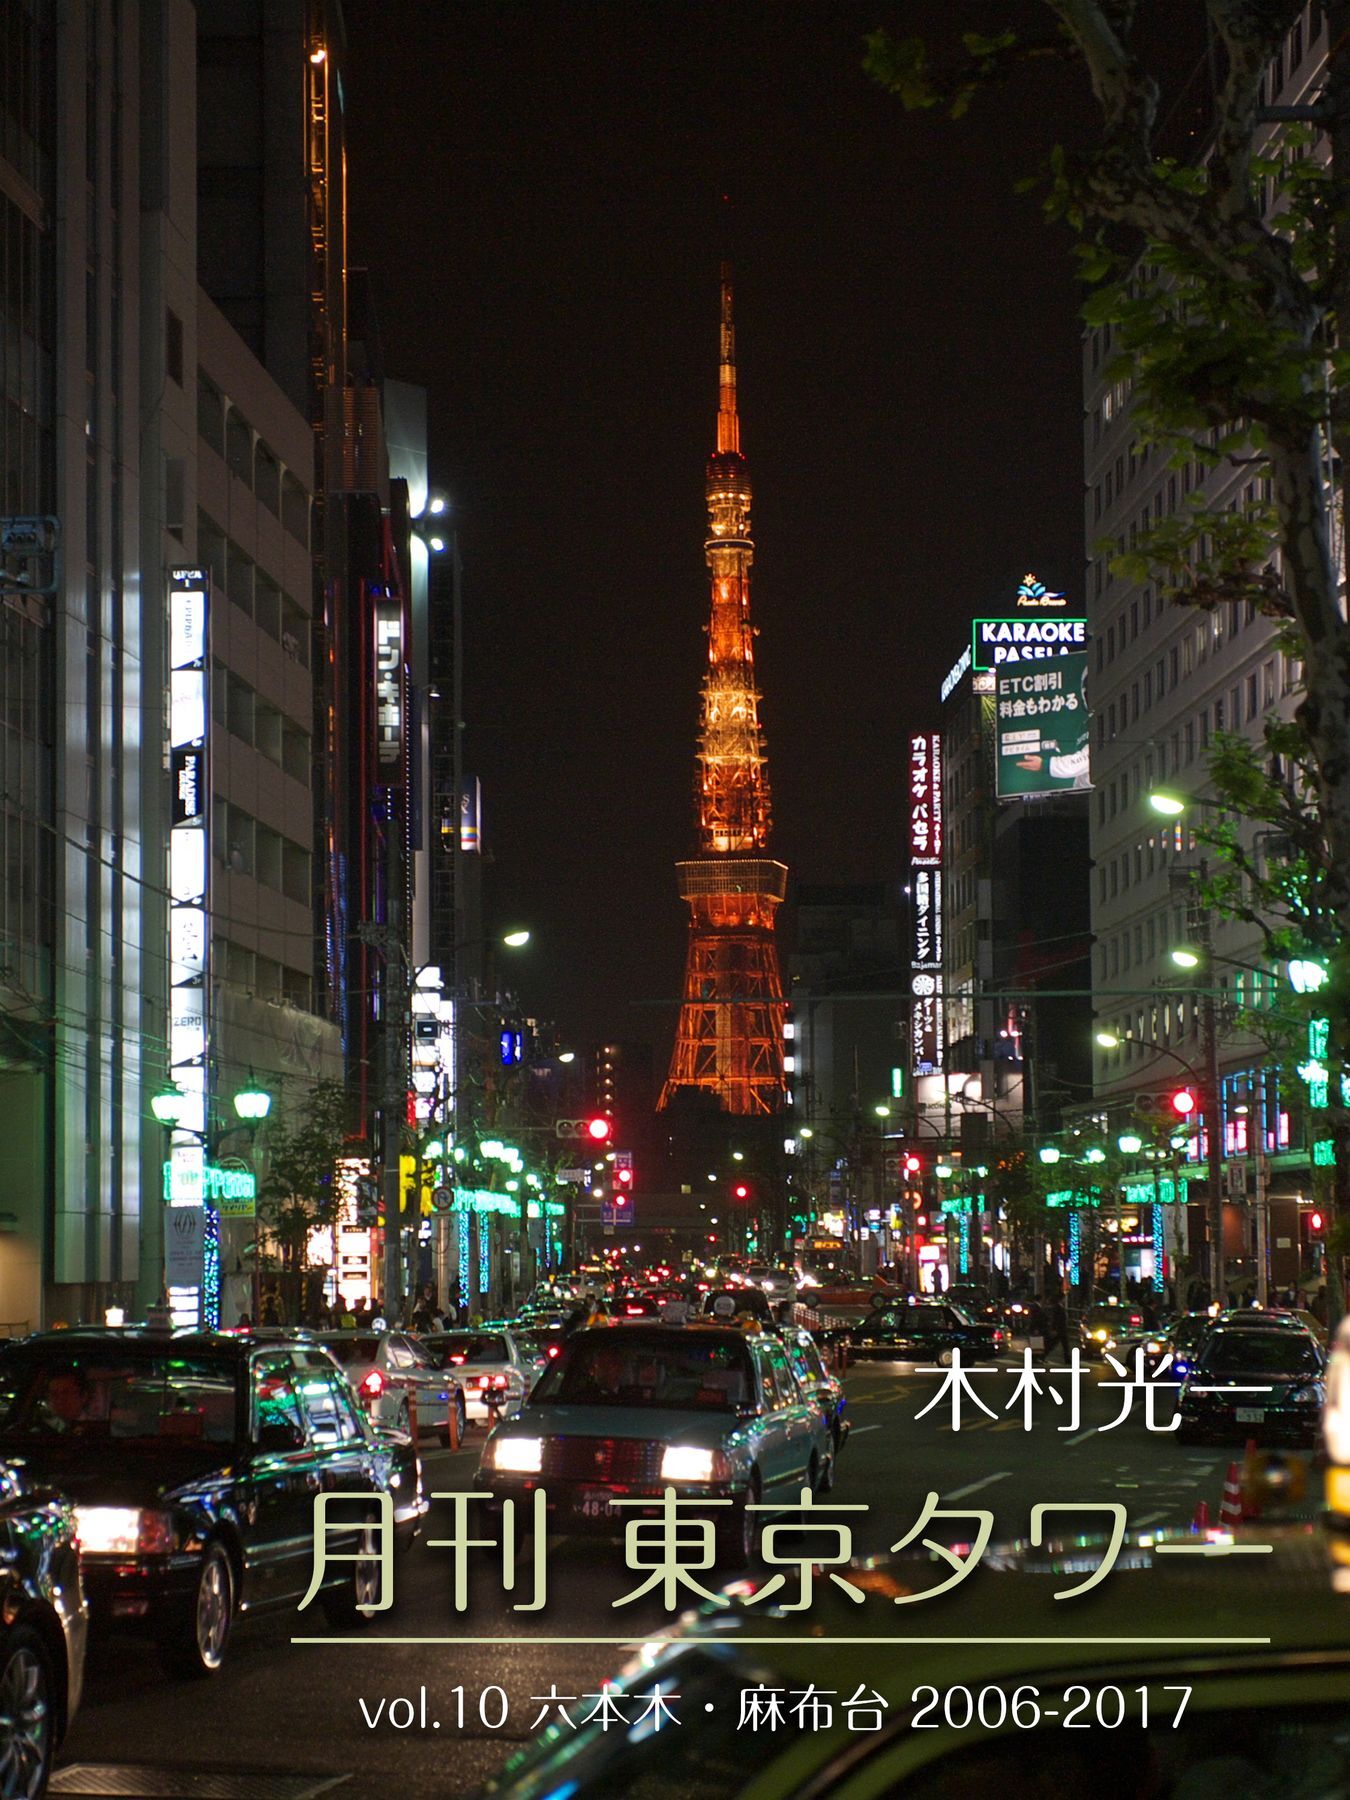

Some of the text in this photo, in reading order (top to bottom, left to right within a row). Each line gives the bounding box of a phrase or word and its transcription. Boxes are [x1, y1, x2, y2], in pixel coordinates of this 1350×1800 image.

[982, 622, 1085, 643] KARAOKE
[999, 671, 1063, 696] ETC割引
[999, 692, 1079, 719] 料金もわかる
[911, 735, 929, 799] カラオケ
[185, 755, 196, 816] PARADISE
[174, 1016, 201, 1027] ZERO
